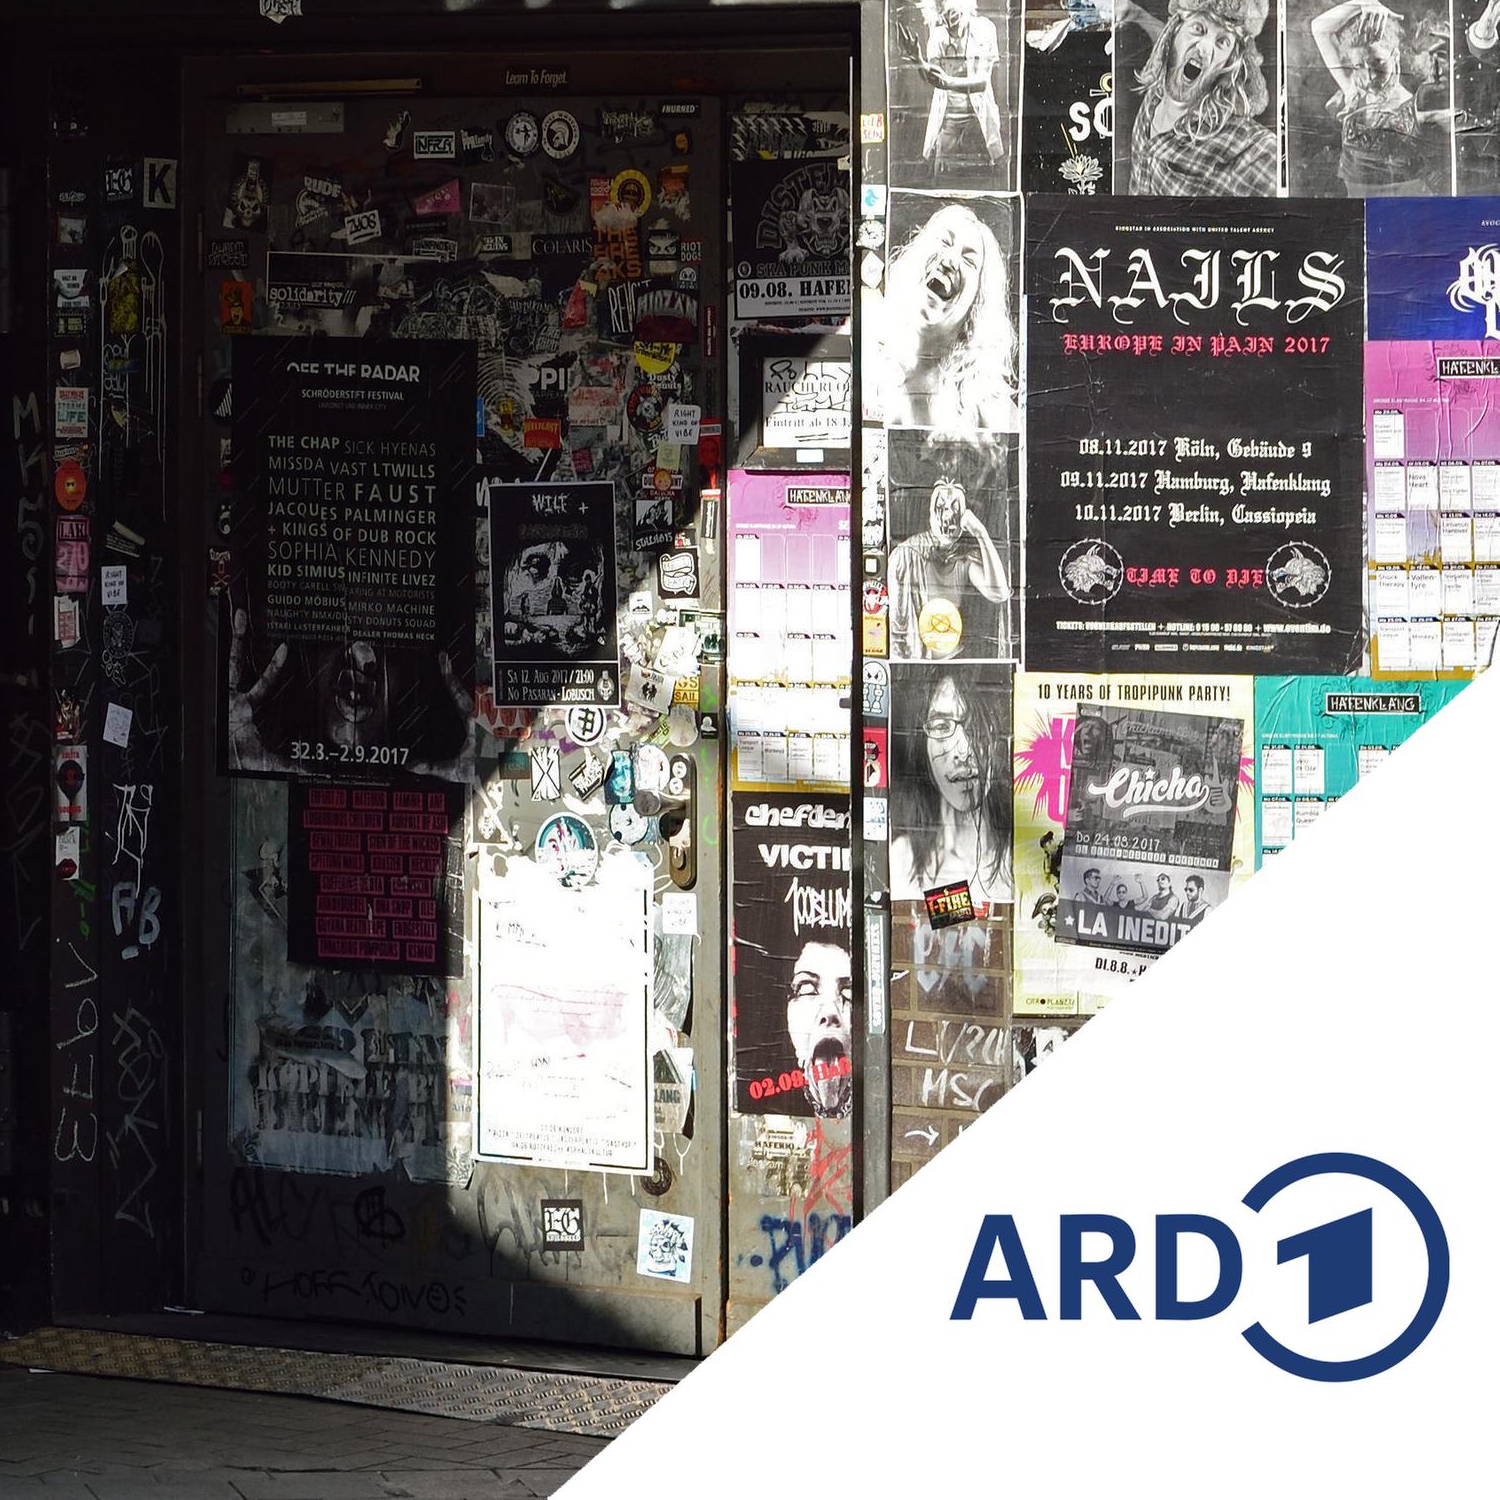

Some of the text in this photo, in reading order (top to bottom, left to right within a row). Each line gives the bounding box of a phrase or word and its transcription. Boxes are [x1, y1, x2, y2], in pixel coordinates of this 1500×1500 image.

[530, 70, 538, 84] To
[739, 282, 793, 299] 09.08.
[1049, 246, 1347, 326] NAILS
[1061, 333, 1331, 357] EUROPE IN PAIN 2017
[674, 409, 696, 418] RIGHT
[268, 435, 437, 458] THE CHAP SICK HYENAS
[1079, 438, 1168, 458] 08.11.2017
[268, 476, 437, 505] MUTTER FAUST
[1060, 470, 1149, 490] 09.11.2017
[1240, 470, 1332, 497] Hafenklang
[268, 501, 437, 525] JACQUES PALMINGER
[1074, 504, 1162, 523] 10.11.2017
[268, 541, 437, 569] SOPHIA KENNEDY
[1190, 568, 1217, 585] TO
[1038, 684, 1231, 701] 10 YEARS OF TROPIPUNK PARTY!
[1088, 766, 1210, 818] Chicha
[1076, 831, 1090, 844] Do
[1078, 909, 1107, 938] LA
